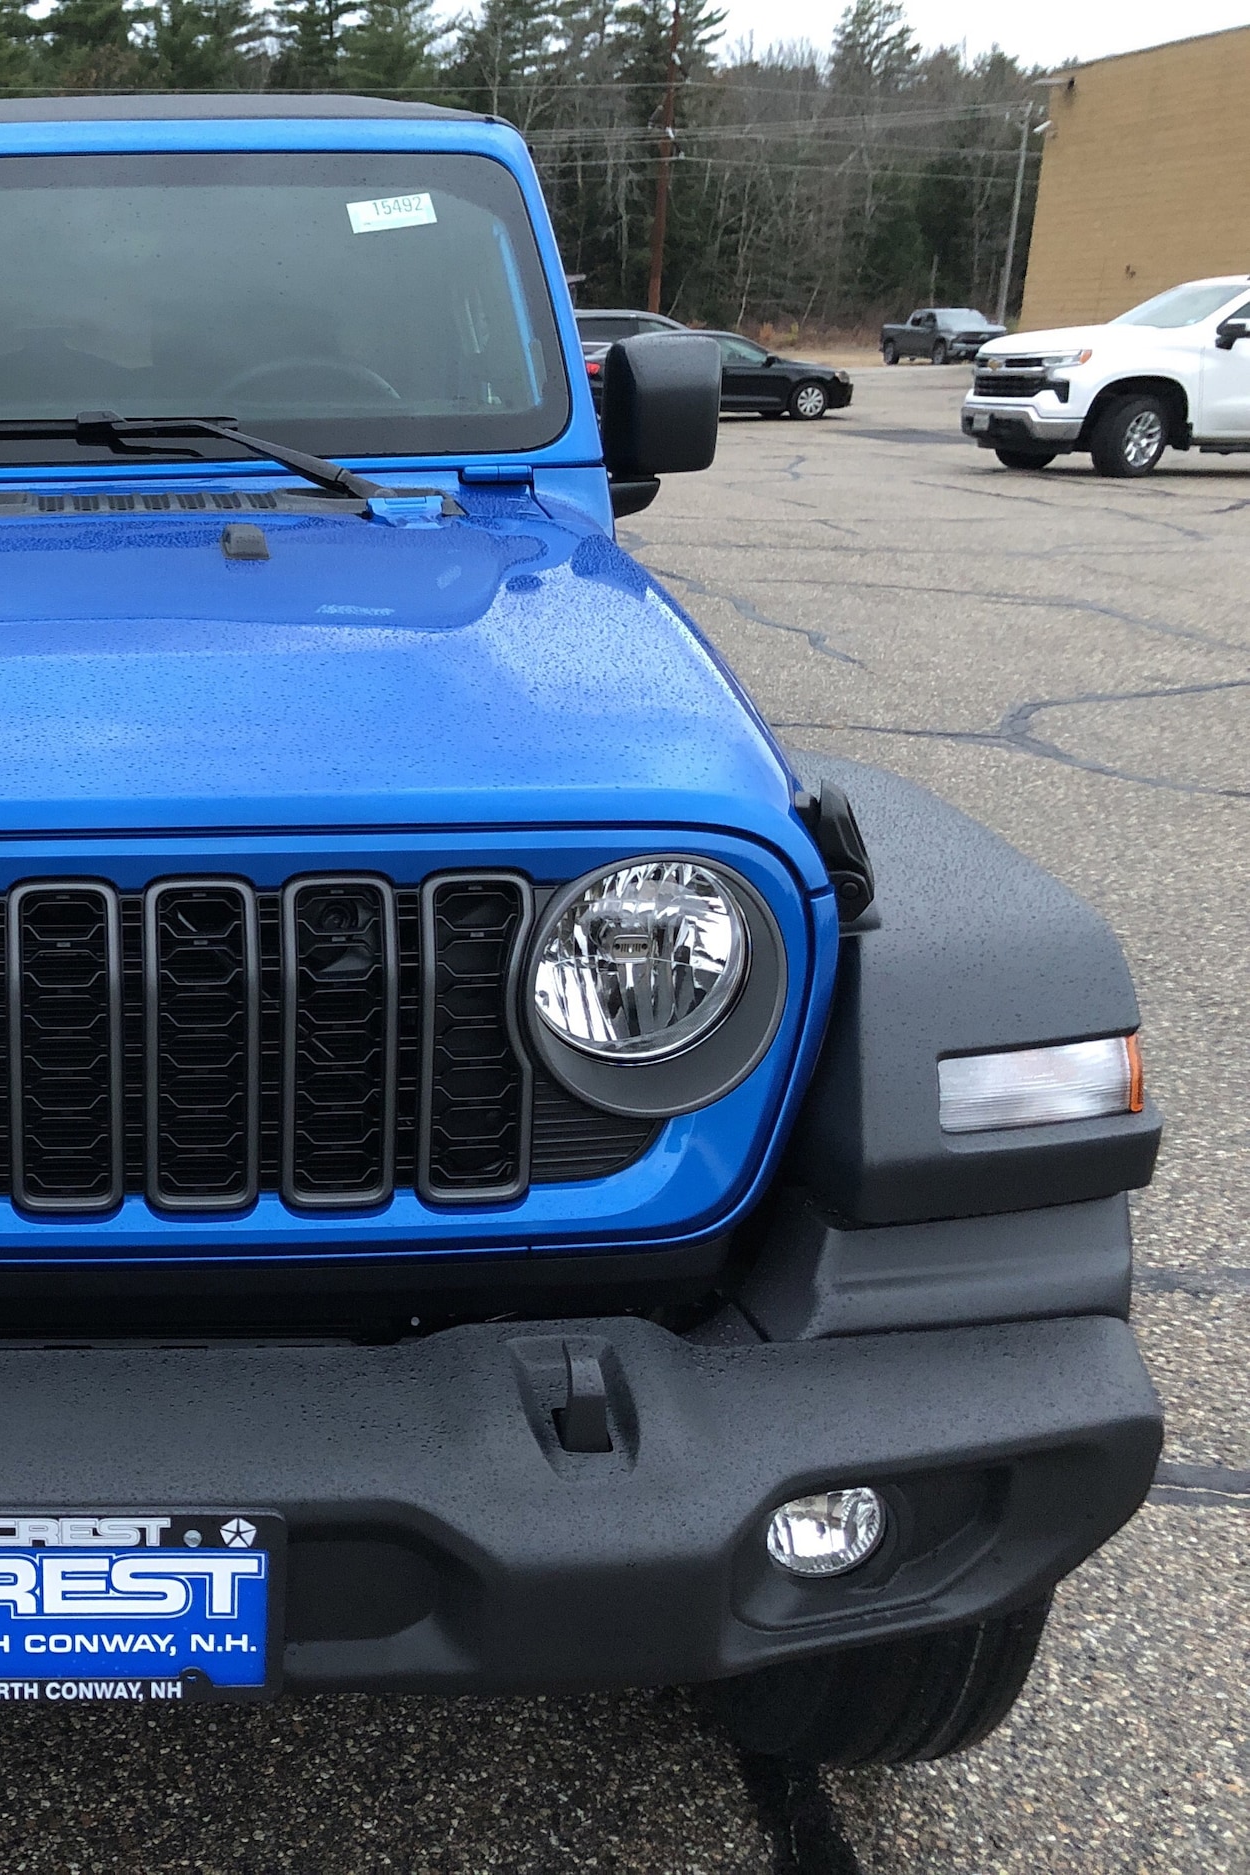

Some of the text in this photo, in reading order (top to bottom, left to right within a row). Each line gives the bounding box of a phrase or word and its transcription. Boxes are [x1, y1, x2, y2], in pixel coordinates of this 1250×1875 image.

[372, 196, 423, 216] 15492
[24, 1634, 177, 1657] CONWAY,
[190, 1633, 257, 1653] N.H.
[45, 1681, 144, 1701] CONWAY,
[150, 1681, 182, 1699] NH
